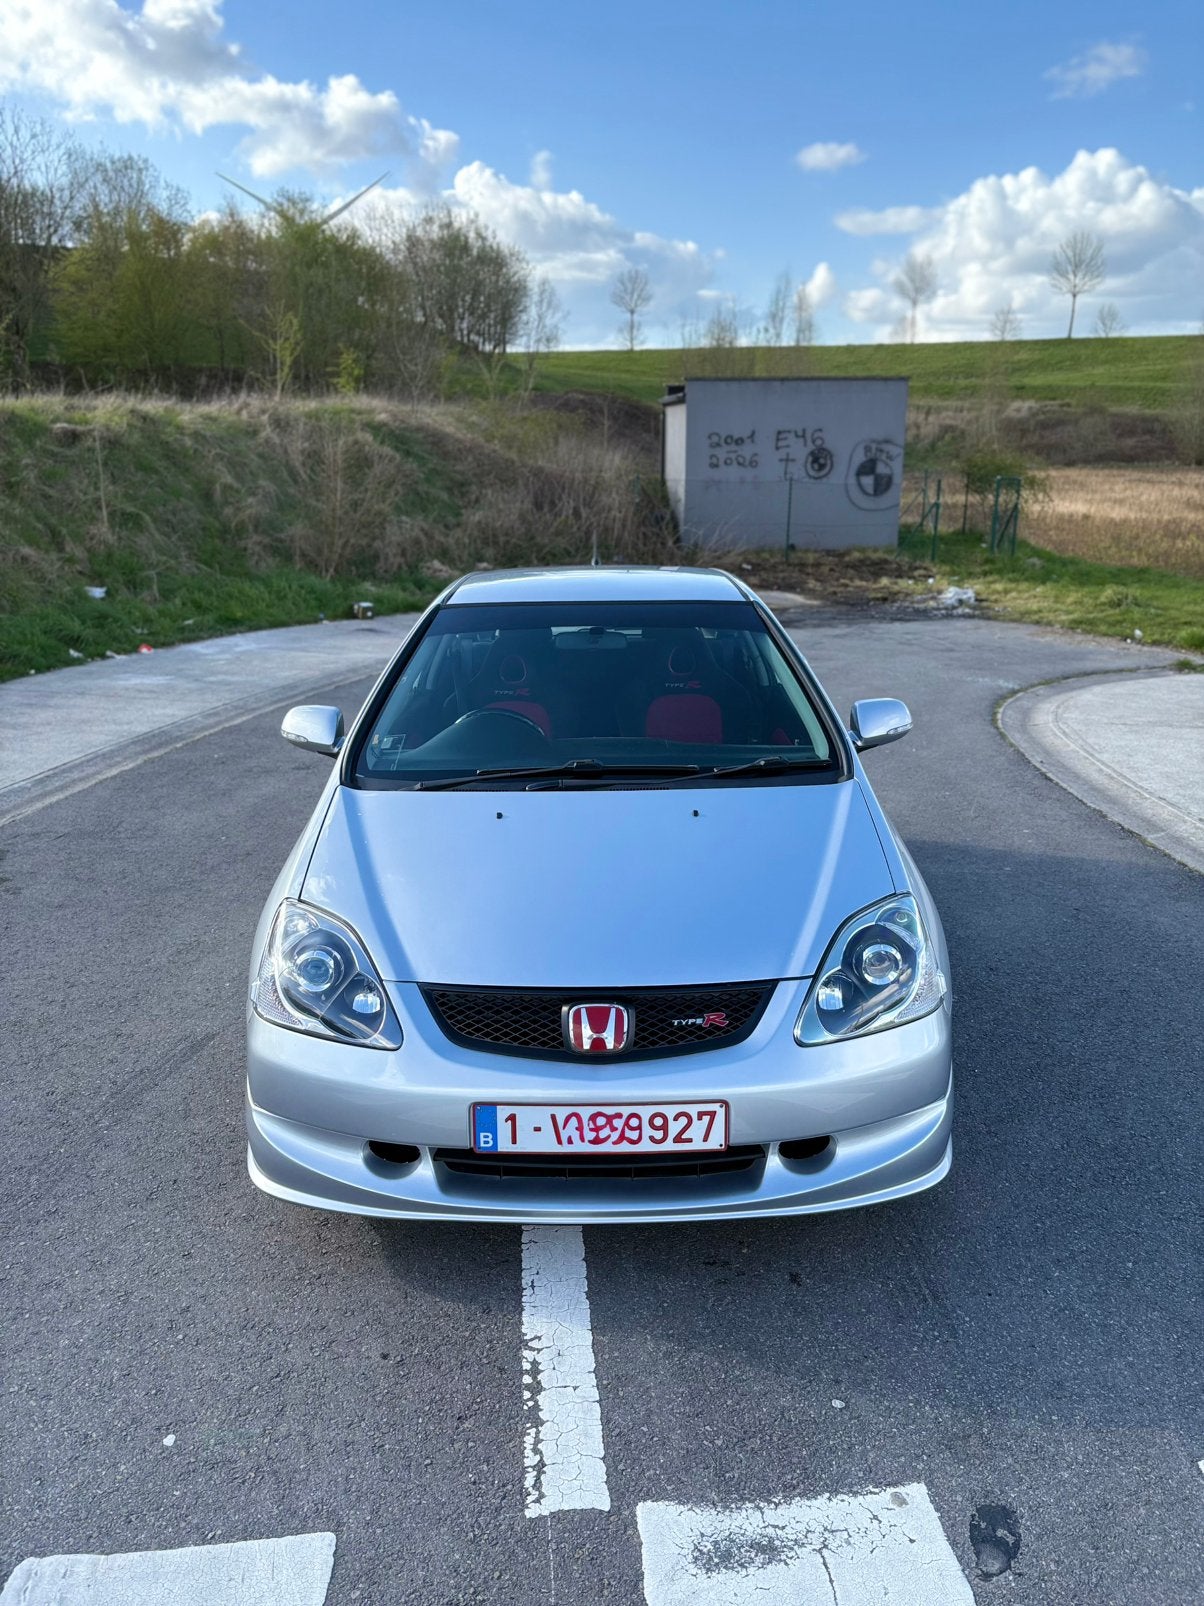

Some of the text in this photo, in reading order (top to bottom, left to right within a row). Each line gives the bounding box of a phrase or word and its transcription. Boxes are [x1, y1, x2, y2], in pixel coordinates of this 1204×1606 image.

[708, 430, 756, 449] 2001
[775, 428, 825, 450] E46
[672, 1012, 729, 1028] TYPE R
[479, 1132, 494, 1147] B
